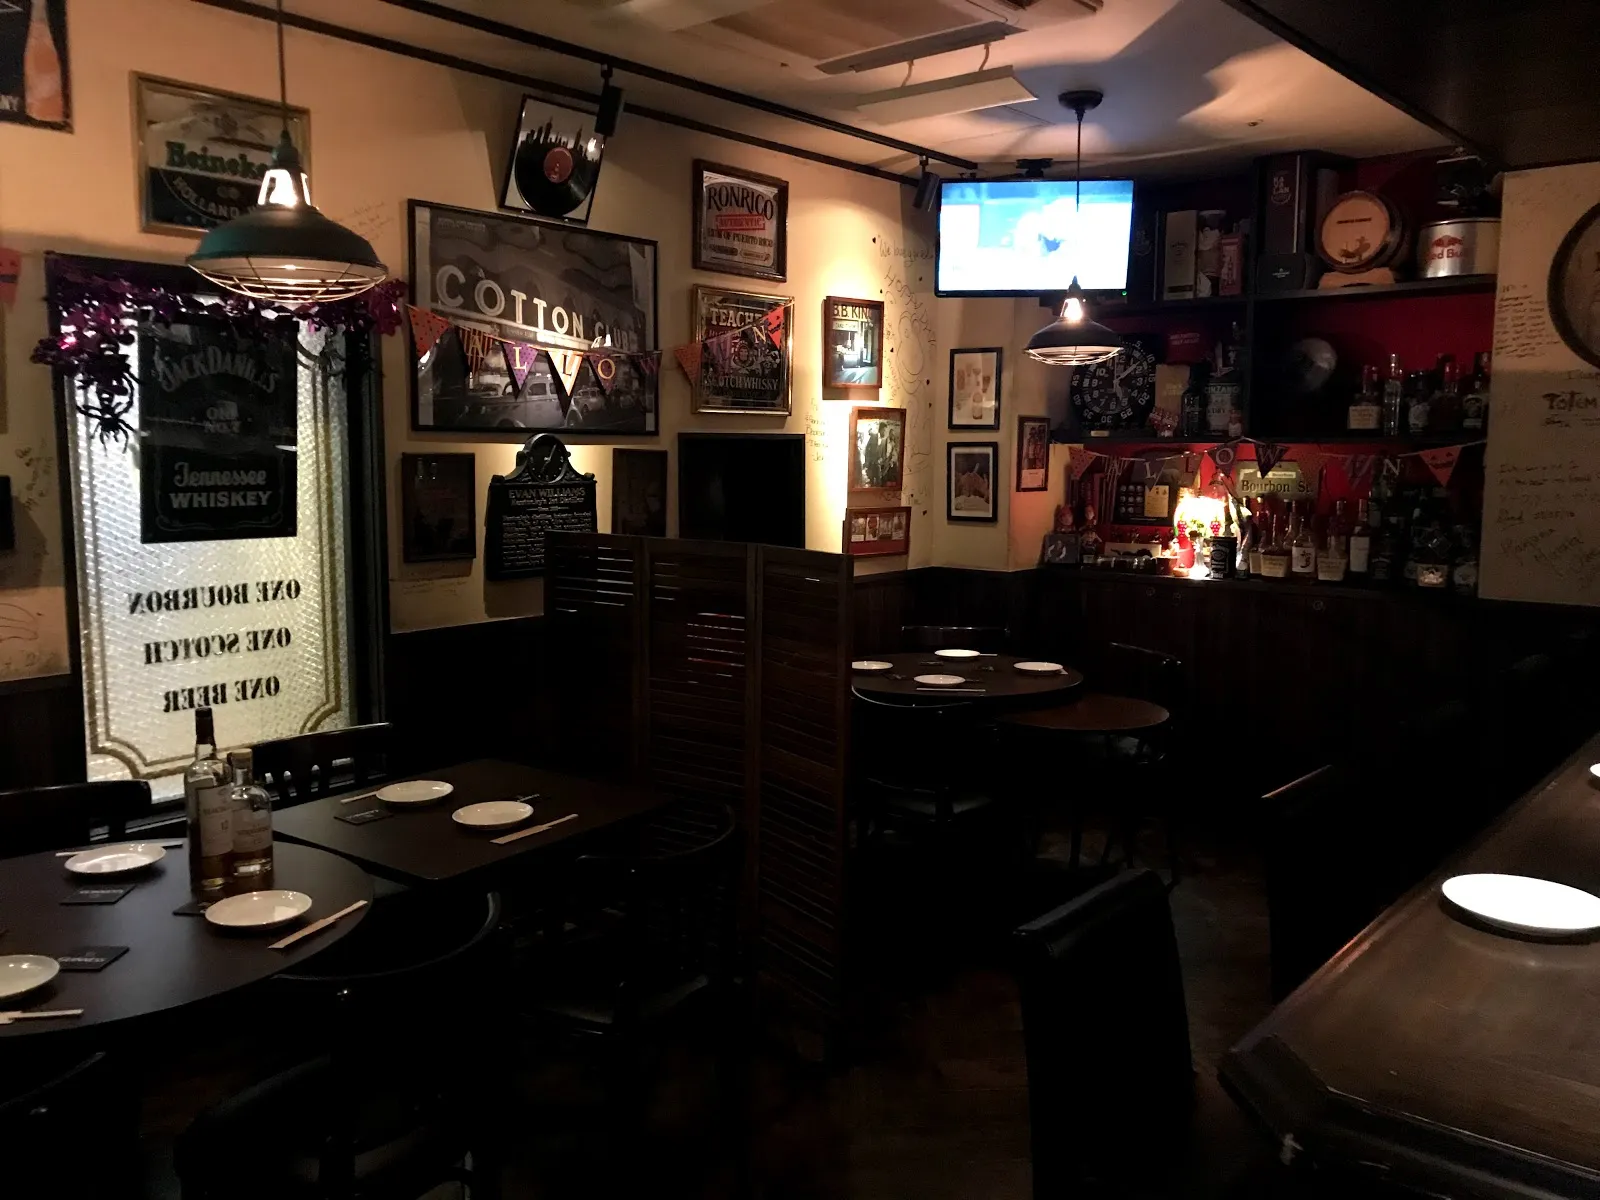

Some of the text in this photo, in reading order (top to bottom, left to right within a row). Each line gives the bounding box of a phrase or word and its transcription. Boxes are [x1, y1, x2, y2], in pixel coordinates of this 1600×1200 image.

[166, 141, 269, 180] Heineke
[708, 186, 774, 220] RONRICO
[436, 265, 584, 339] COTTON
[743, 377, 778, 391] WHISKY
[173, 462, 267, 487] Tennessee
[508, 487, 586, 499] EVAN WILLIAMS
[1242, 480, 1290, 492] Bourbon
[168, 490, 272, 509] WHISKEY
